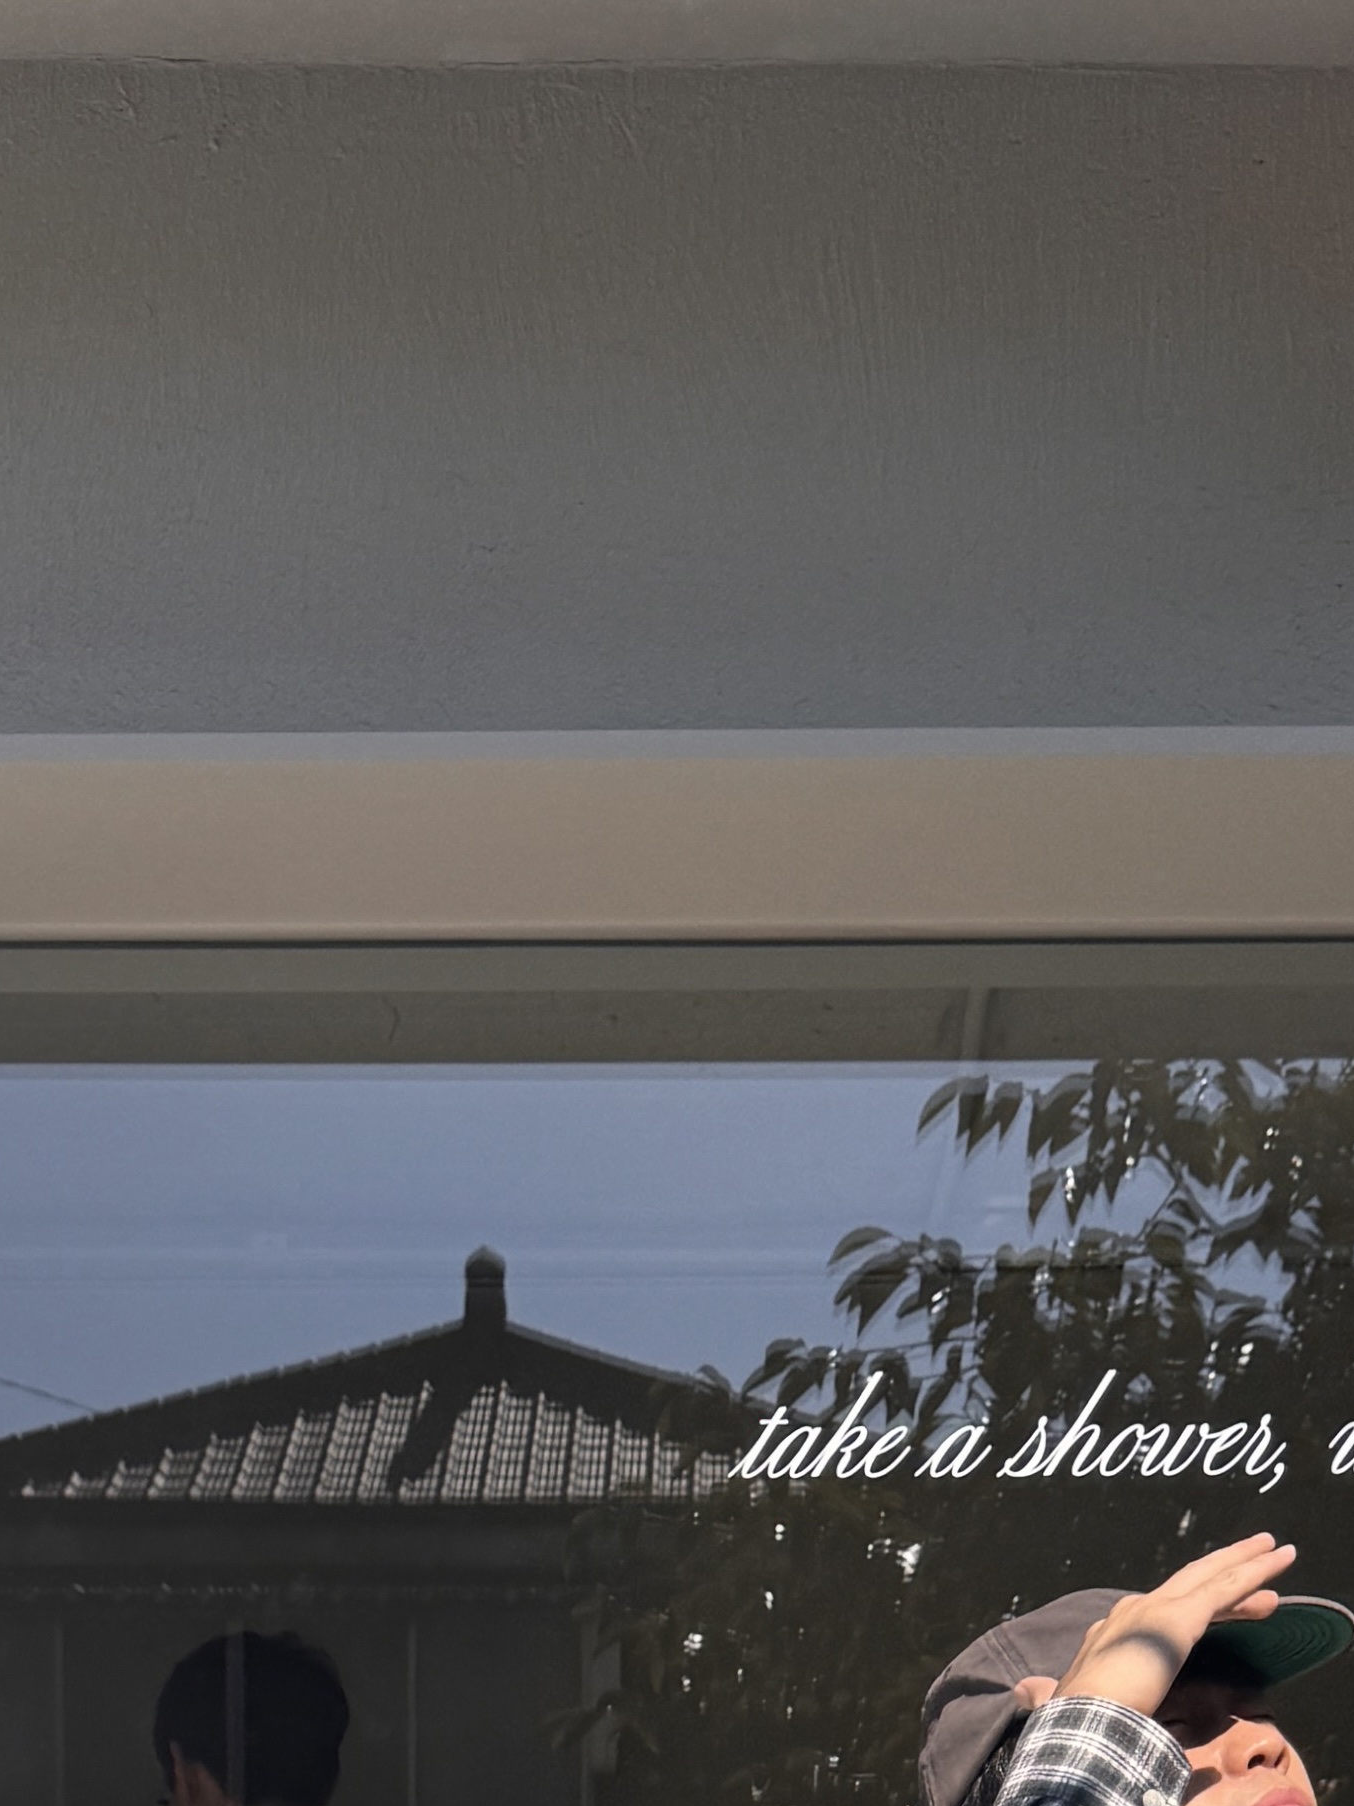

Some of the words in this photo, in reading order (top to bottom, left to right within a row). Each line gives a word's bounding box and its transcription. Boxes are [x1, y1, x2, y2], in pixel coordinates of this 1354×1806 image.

[727, 1371, 912, 1479] take
[914, 1424, 993, 1479] a
[996, 1368, 1287, 1493] shower,
